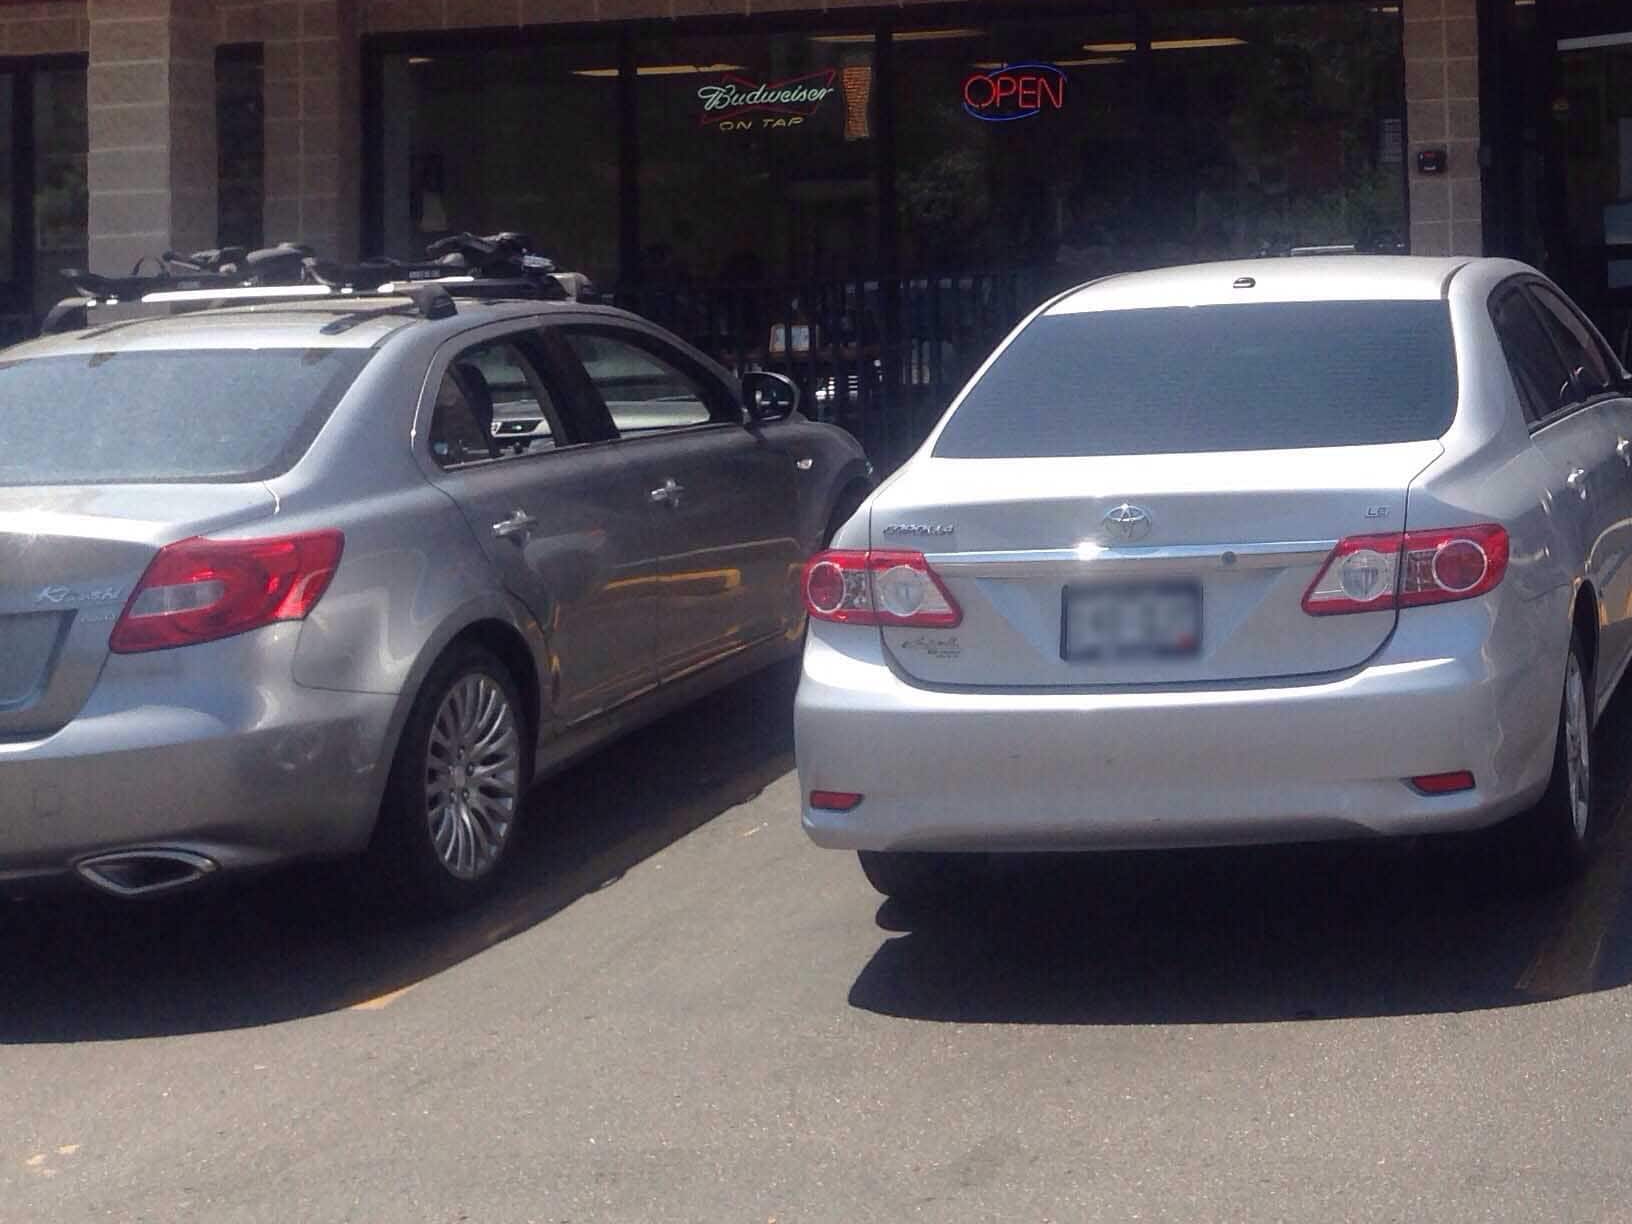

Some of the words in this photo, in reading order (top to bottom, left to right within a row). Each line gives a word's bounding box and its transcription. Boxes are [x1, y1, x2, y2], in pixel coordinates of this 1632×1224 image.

[698, 83, 834, 111] Budweiser
[964, 75, 1064, 108] OPEN
[719, 120, 752, 131] ON
[762, 116, 804, 128] TAP
